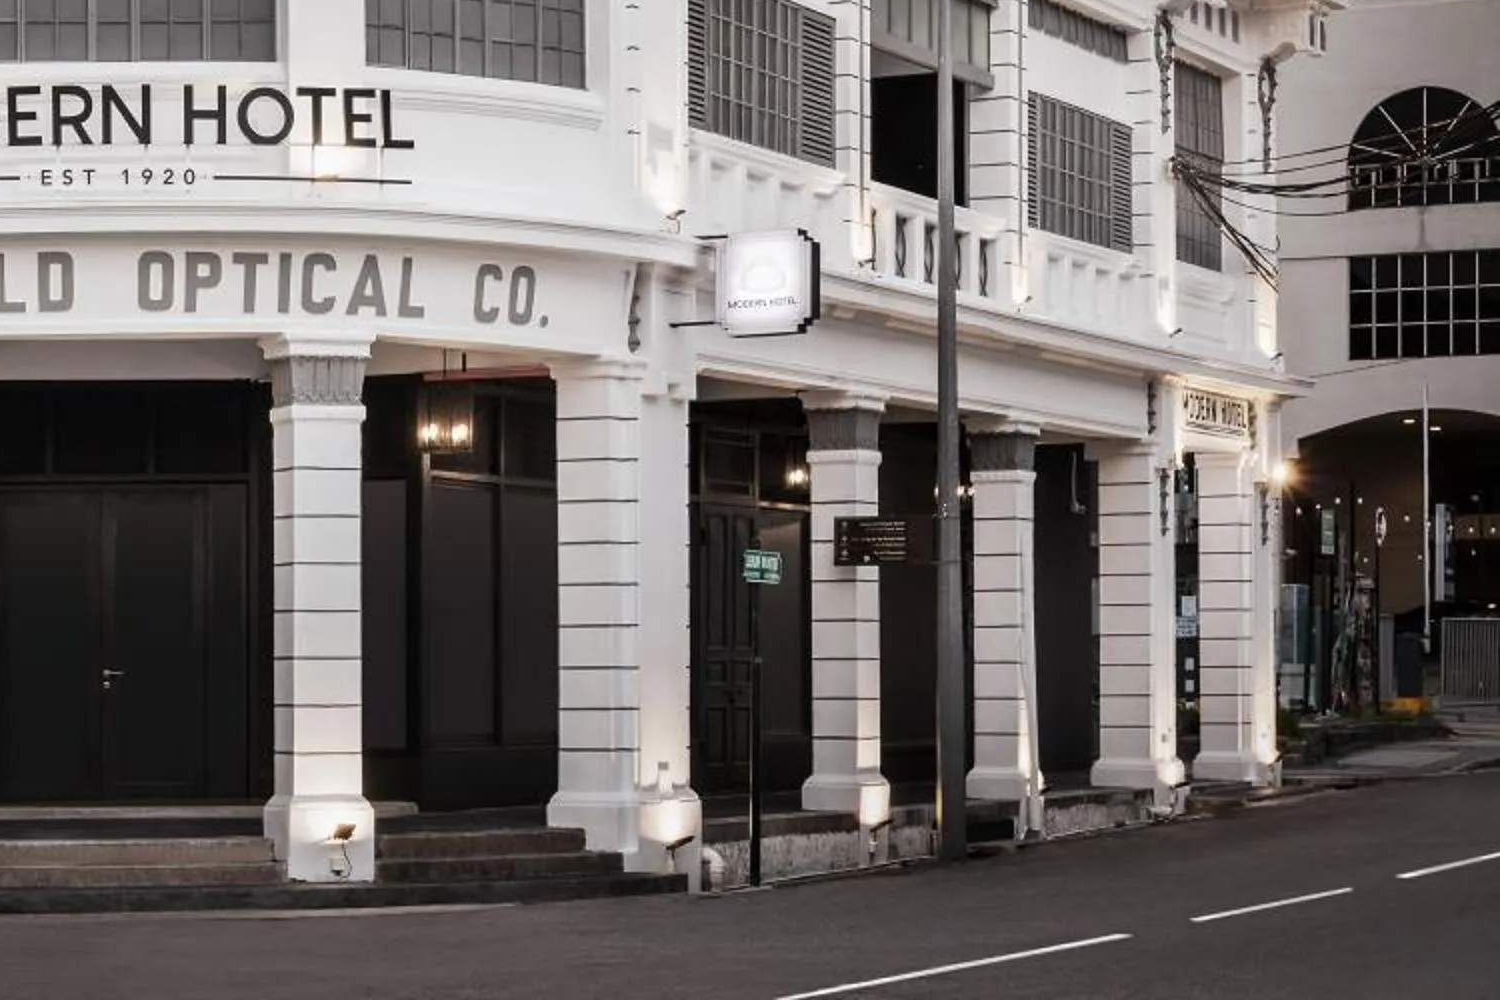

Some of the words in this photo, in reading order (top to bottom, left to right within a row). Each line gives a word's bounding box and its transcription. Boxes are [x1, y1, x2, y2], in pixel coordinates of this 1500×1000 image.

[183, 83, 415, 148] HOTEL
[40, 169, 96, 186] EST
[120, 168, 197, 186] 1920
[137, 250, 425, 319] OPTICAL
[473, 263, 549, 328] CO.
